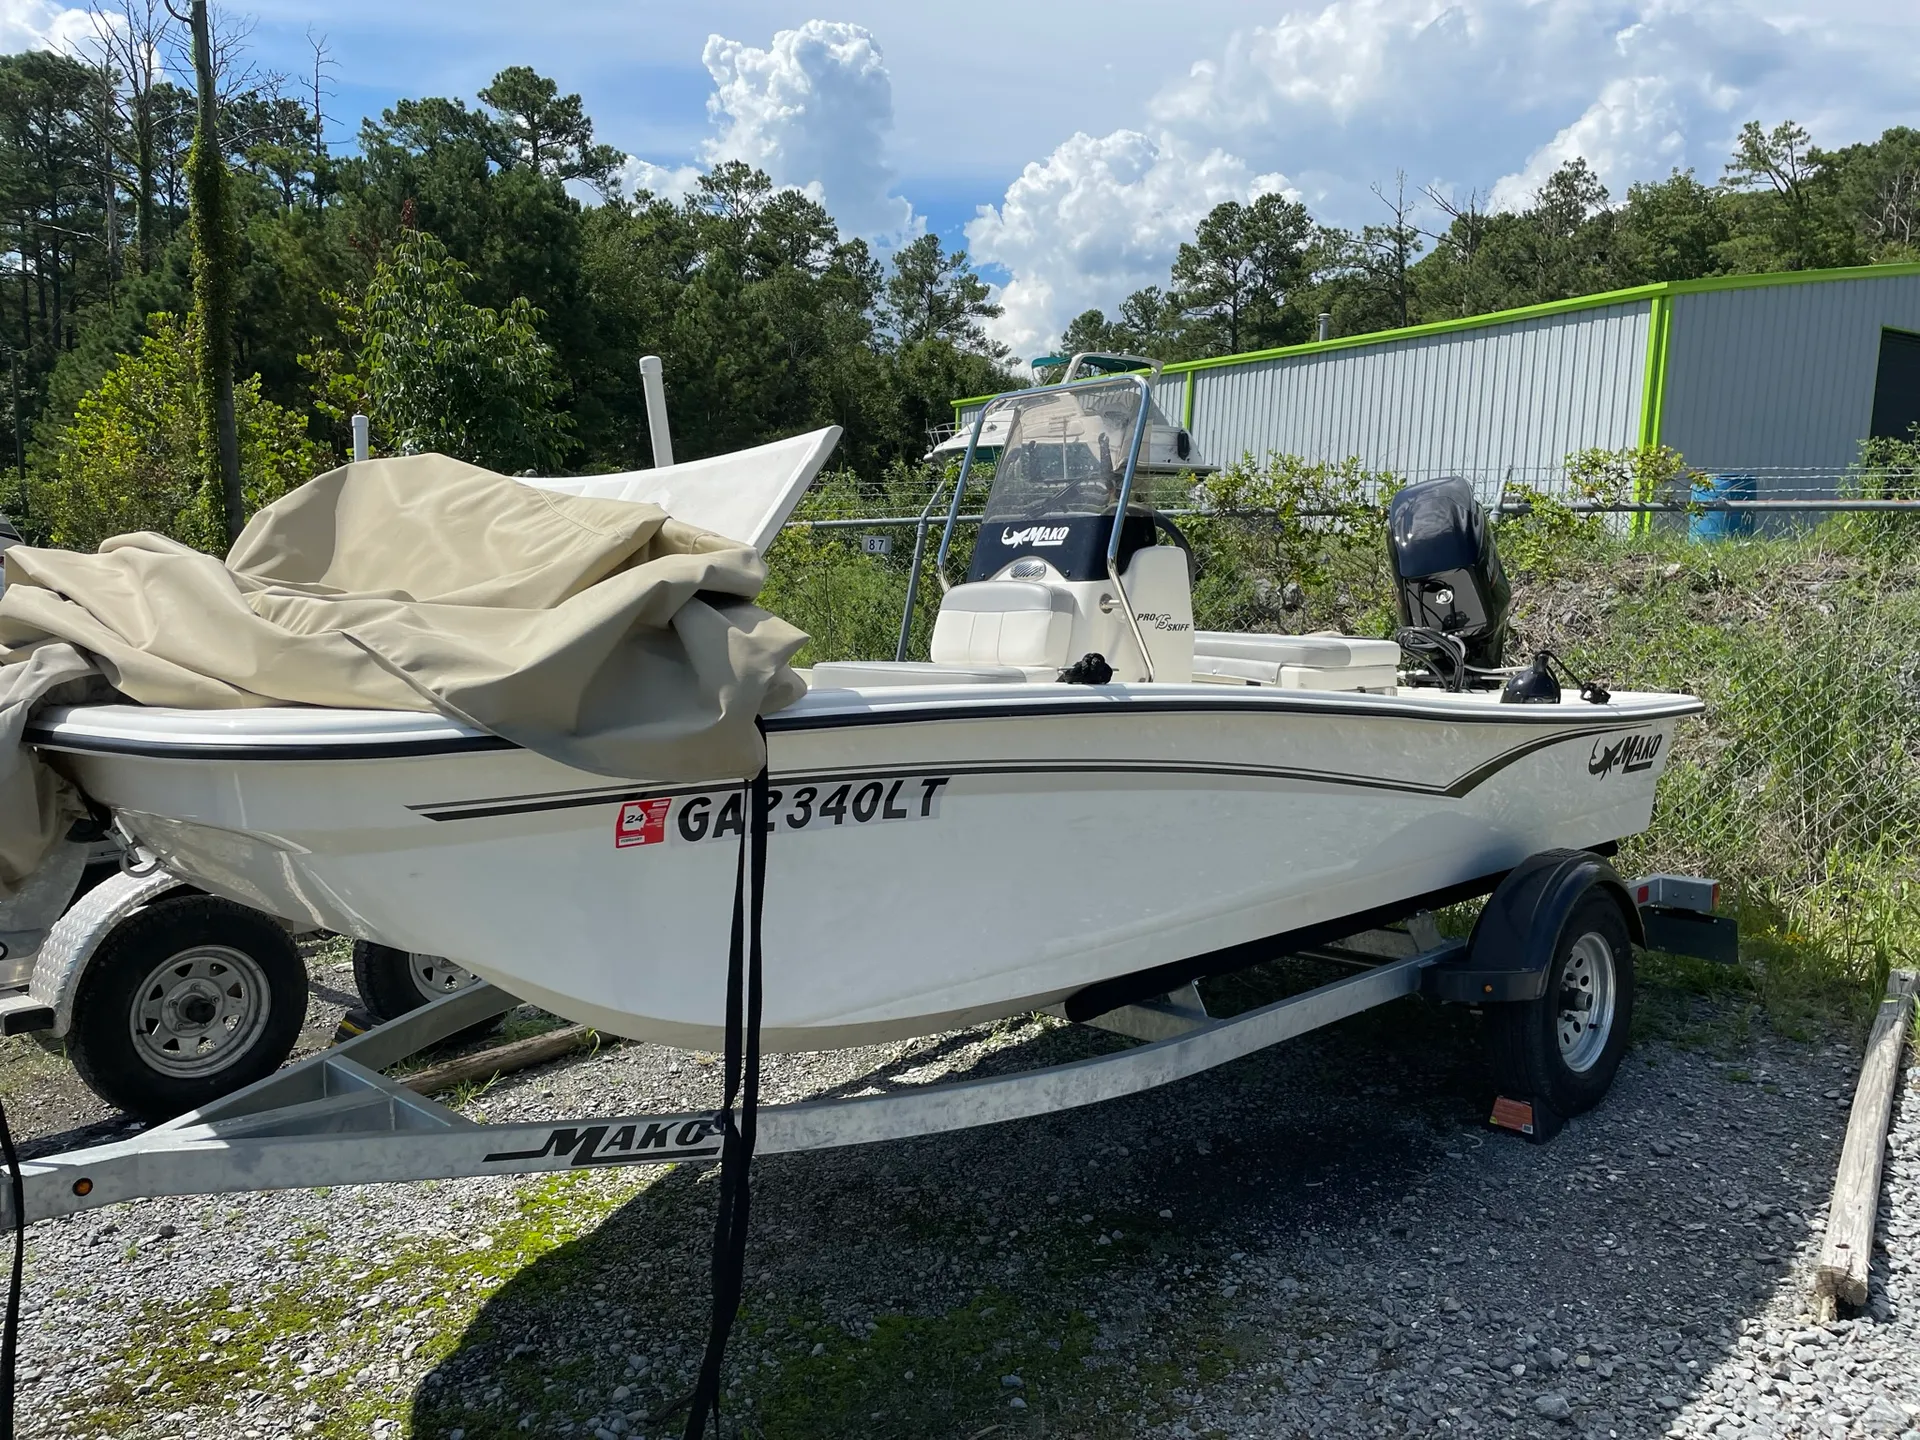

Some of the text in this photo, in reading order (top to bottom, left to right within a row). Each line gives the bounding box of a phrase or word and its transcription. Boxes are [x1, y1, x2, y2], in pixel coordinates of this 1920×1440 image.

[869, 539, 885, 550] 87
[1023, 526, 1070, 546] MAKO
[1137, 613, 1156, 621] PRO
[1155, 614, 1171, 629] 15
[1613, 733, 1663, 774] MAKO
[625, 813, 645, 824] 24
[483, 1119, 720, 1166] MAKO
